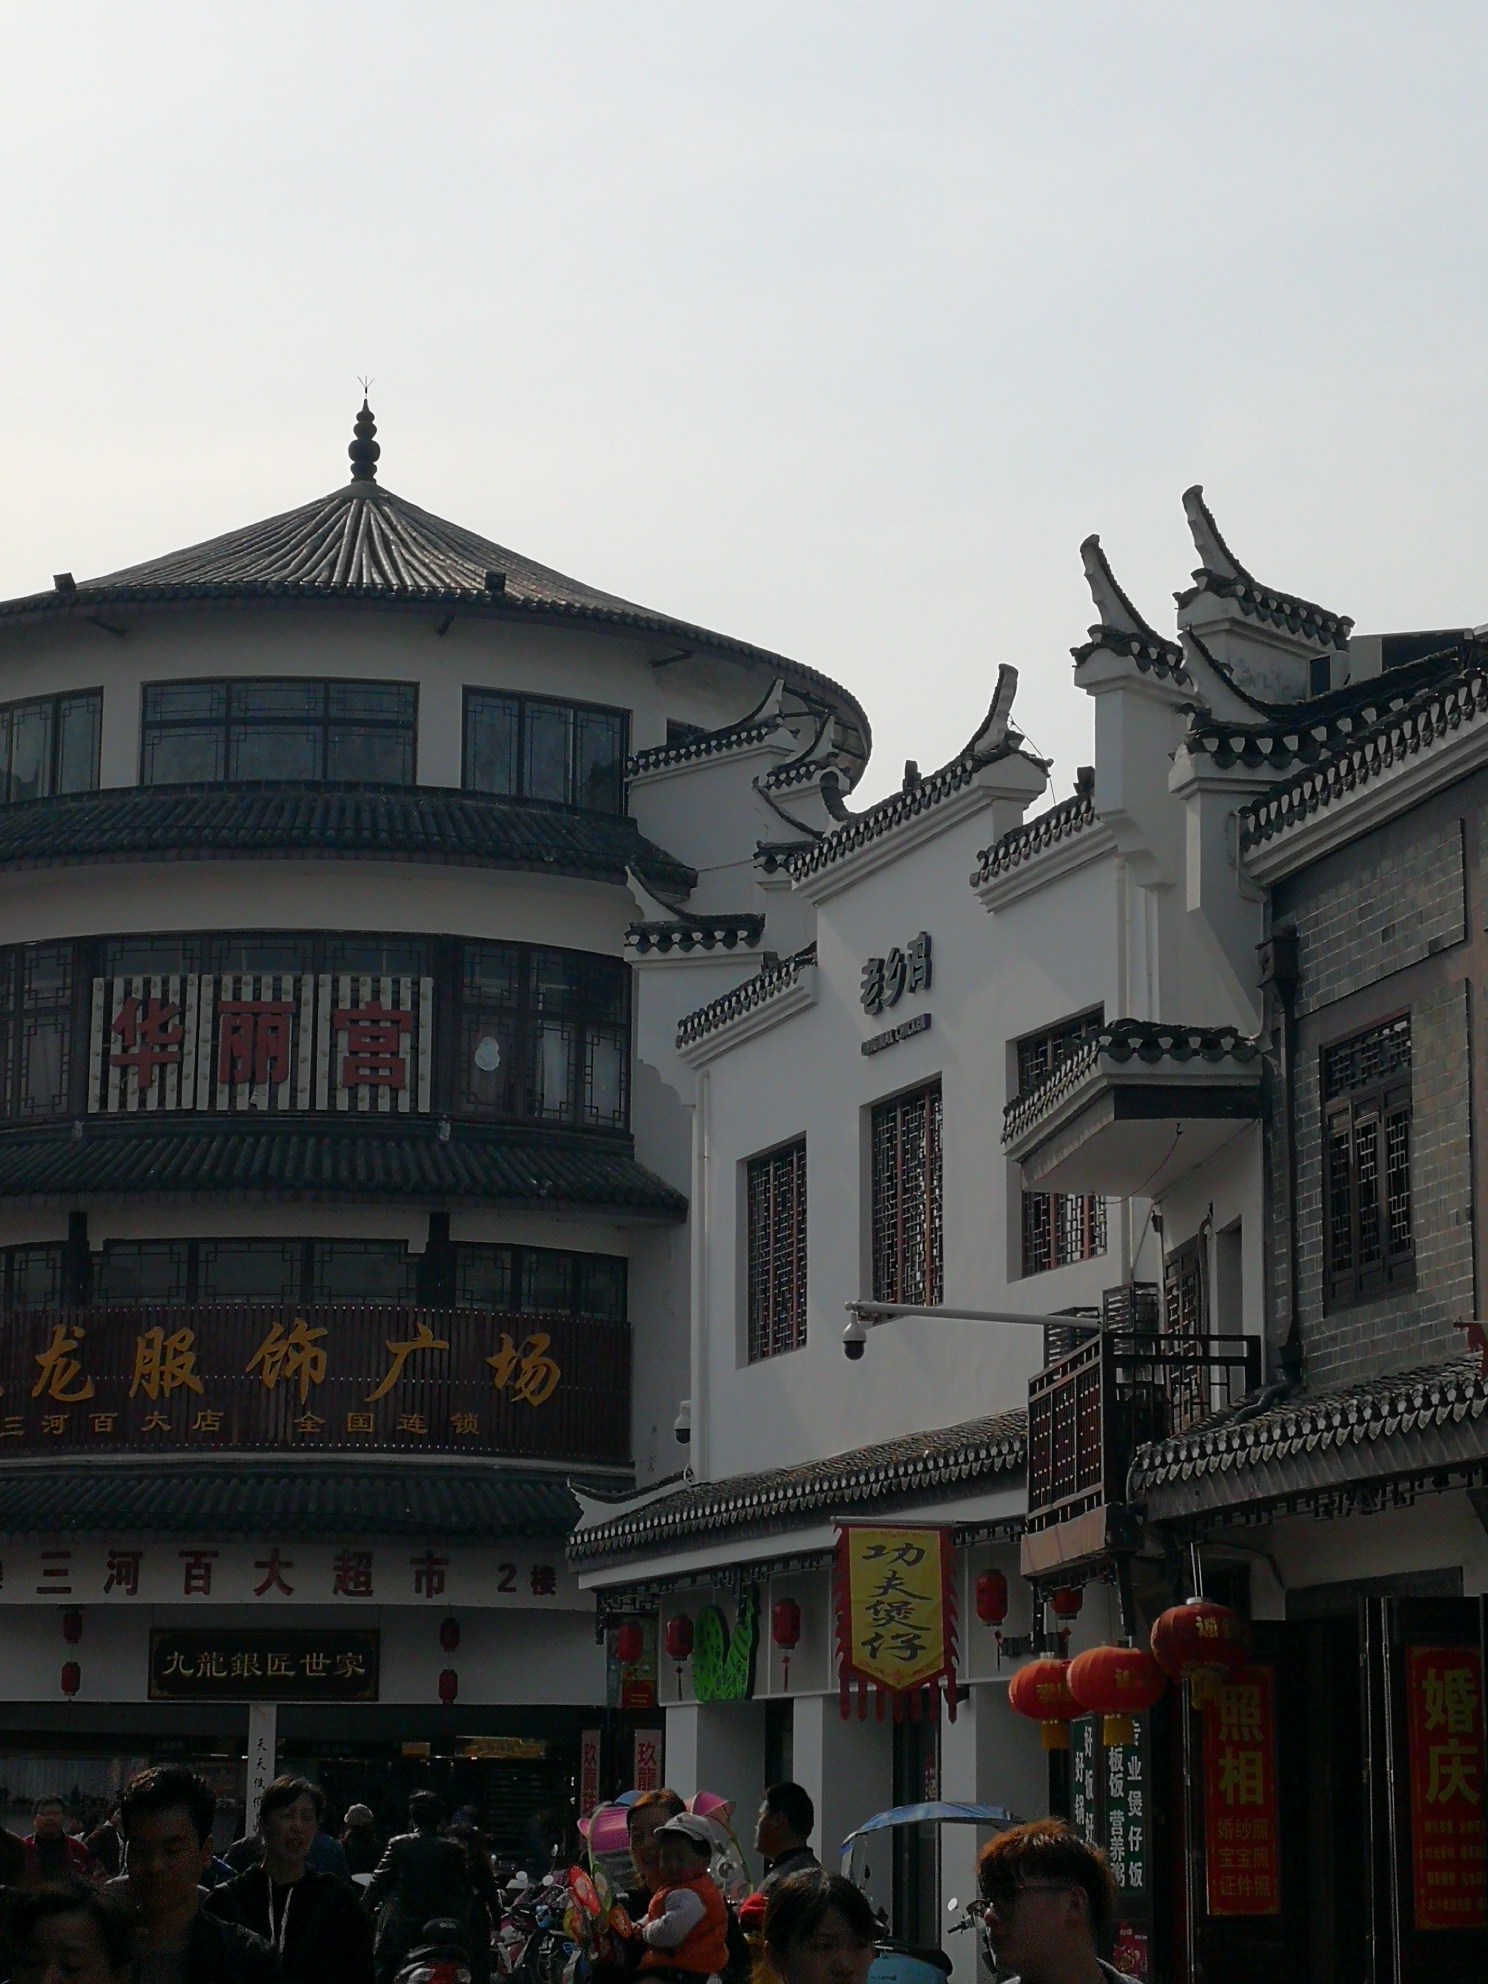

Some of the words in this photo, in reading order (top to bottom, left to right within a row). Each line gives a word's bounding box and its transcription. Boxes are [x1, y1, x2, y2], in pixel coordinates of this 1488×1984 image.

[110, 996, 412, 1091] 华丽宫
[0, 1318, 562, 1407] 龙服饰广场
[0, 1410, 225, 1437] 三河百大店
[294, 1413, 481, 1437] 全国连锁
[37, 1549, 450, 1598] 三河百大超市
[497, 1563, 557, 1596] 2楼
[861, 1541, 932, 1662] 功夫煲仔
[161, 1650, 366, 1679] 九龍銀匠世家
[1218, 1685, 1264, 1806] 照相
[1421, 1667, 1481, 1804] 婚庆
[1217, 1816, 1269, 1841] 婚纱照
[1218, 1848, 1270, 1869] 宝宝照
[1219, 1875, 1271, 1898] 证件照
